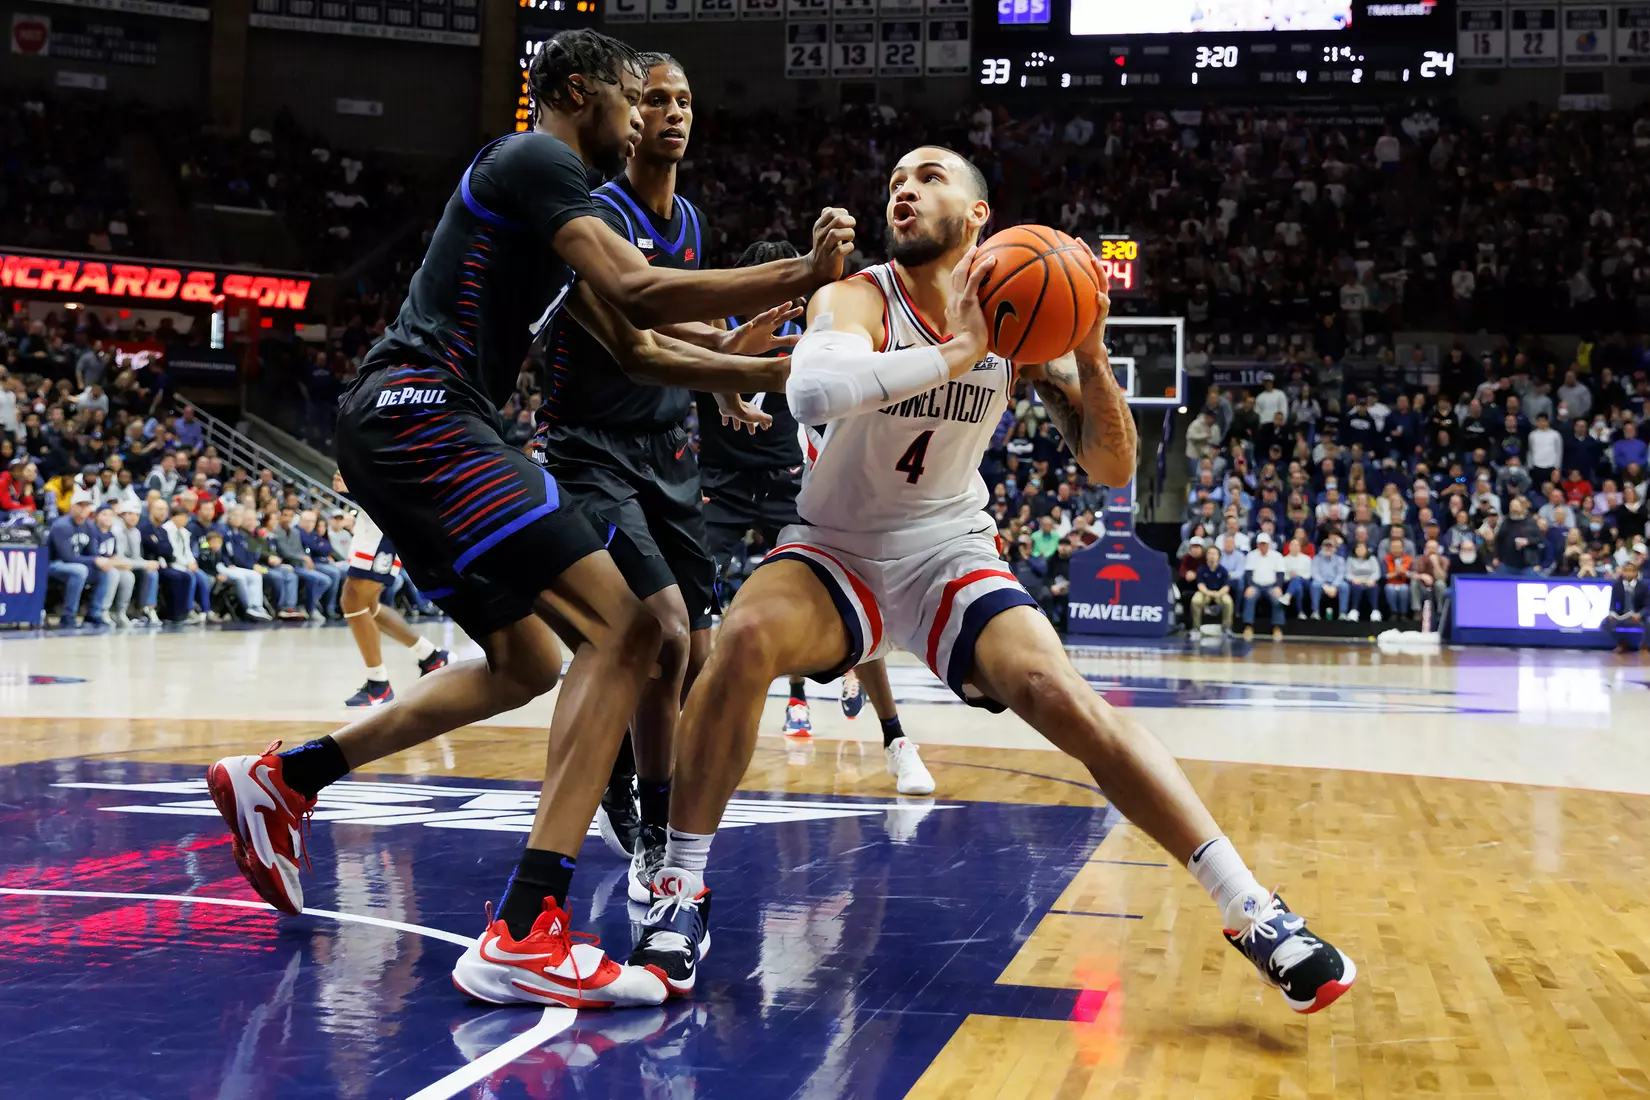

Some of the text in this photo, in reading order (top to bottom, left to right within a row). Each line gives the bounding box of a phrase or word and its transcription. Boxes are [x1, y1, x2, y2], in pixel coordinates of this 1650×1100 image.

[1473, 33, 1490, 54] 15
[1524, 33, 1543, 54] 22
[791, 46, 823, 66] 24
[842, 44, 866, 65] 13
[886, 44, 915, 65] 22
[1194, 45, 1239, 69] 3:20
[1419, 50, 1455, 79] 24
[980, 58, 1012, 85] 33
[1060, 72, 1071, 88] 3
[1350, 67, 1363, 84] 2
[1101, 240, 1138, 261] 3:20
[0, 255, 182, 299] ICHARD
[222, 273, 311, 310] SON
[894, 429, 936, 486] 4
[1068, 602, 1164, 623] TRAVELERS
[1517, 582, 1613, 630] FOX
